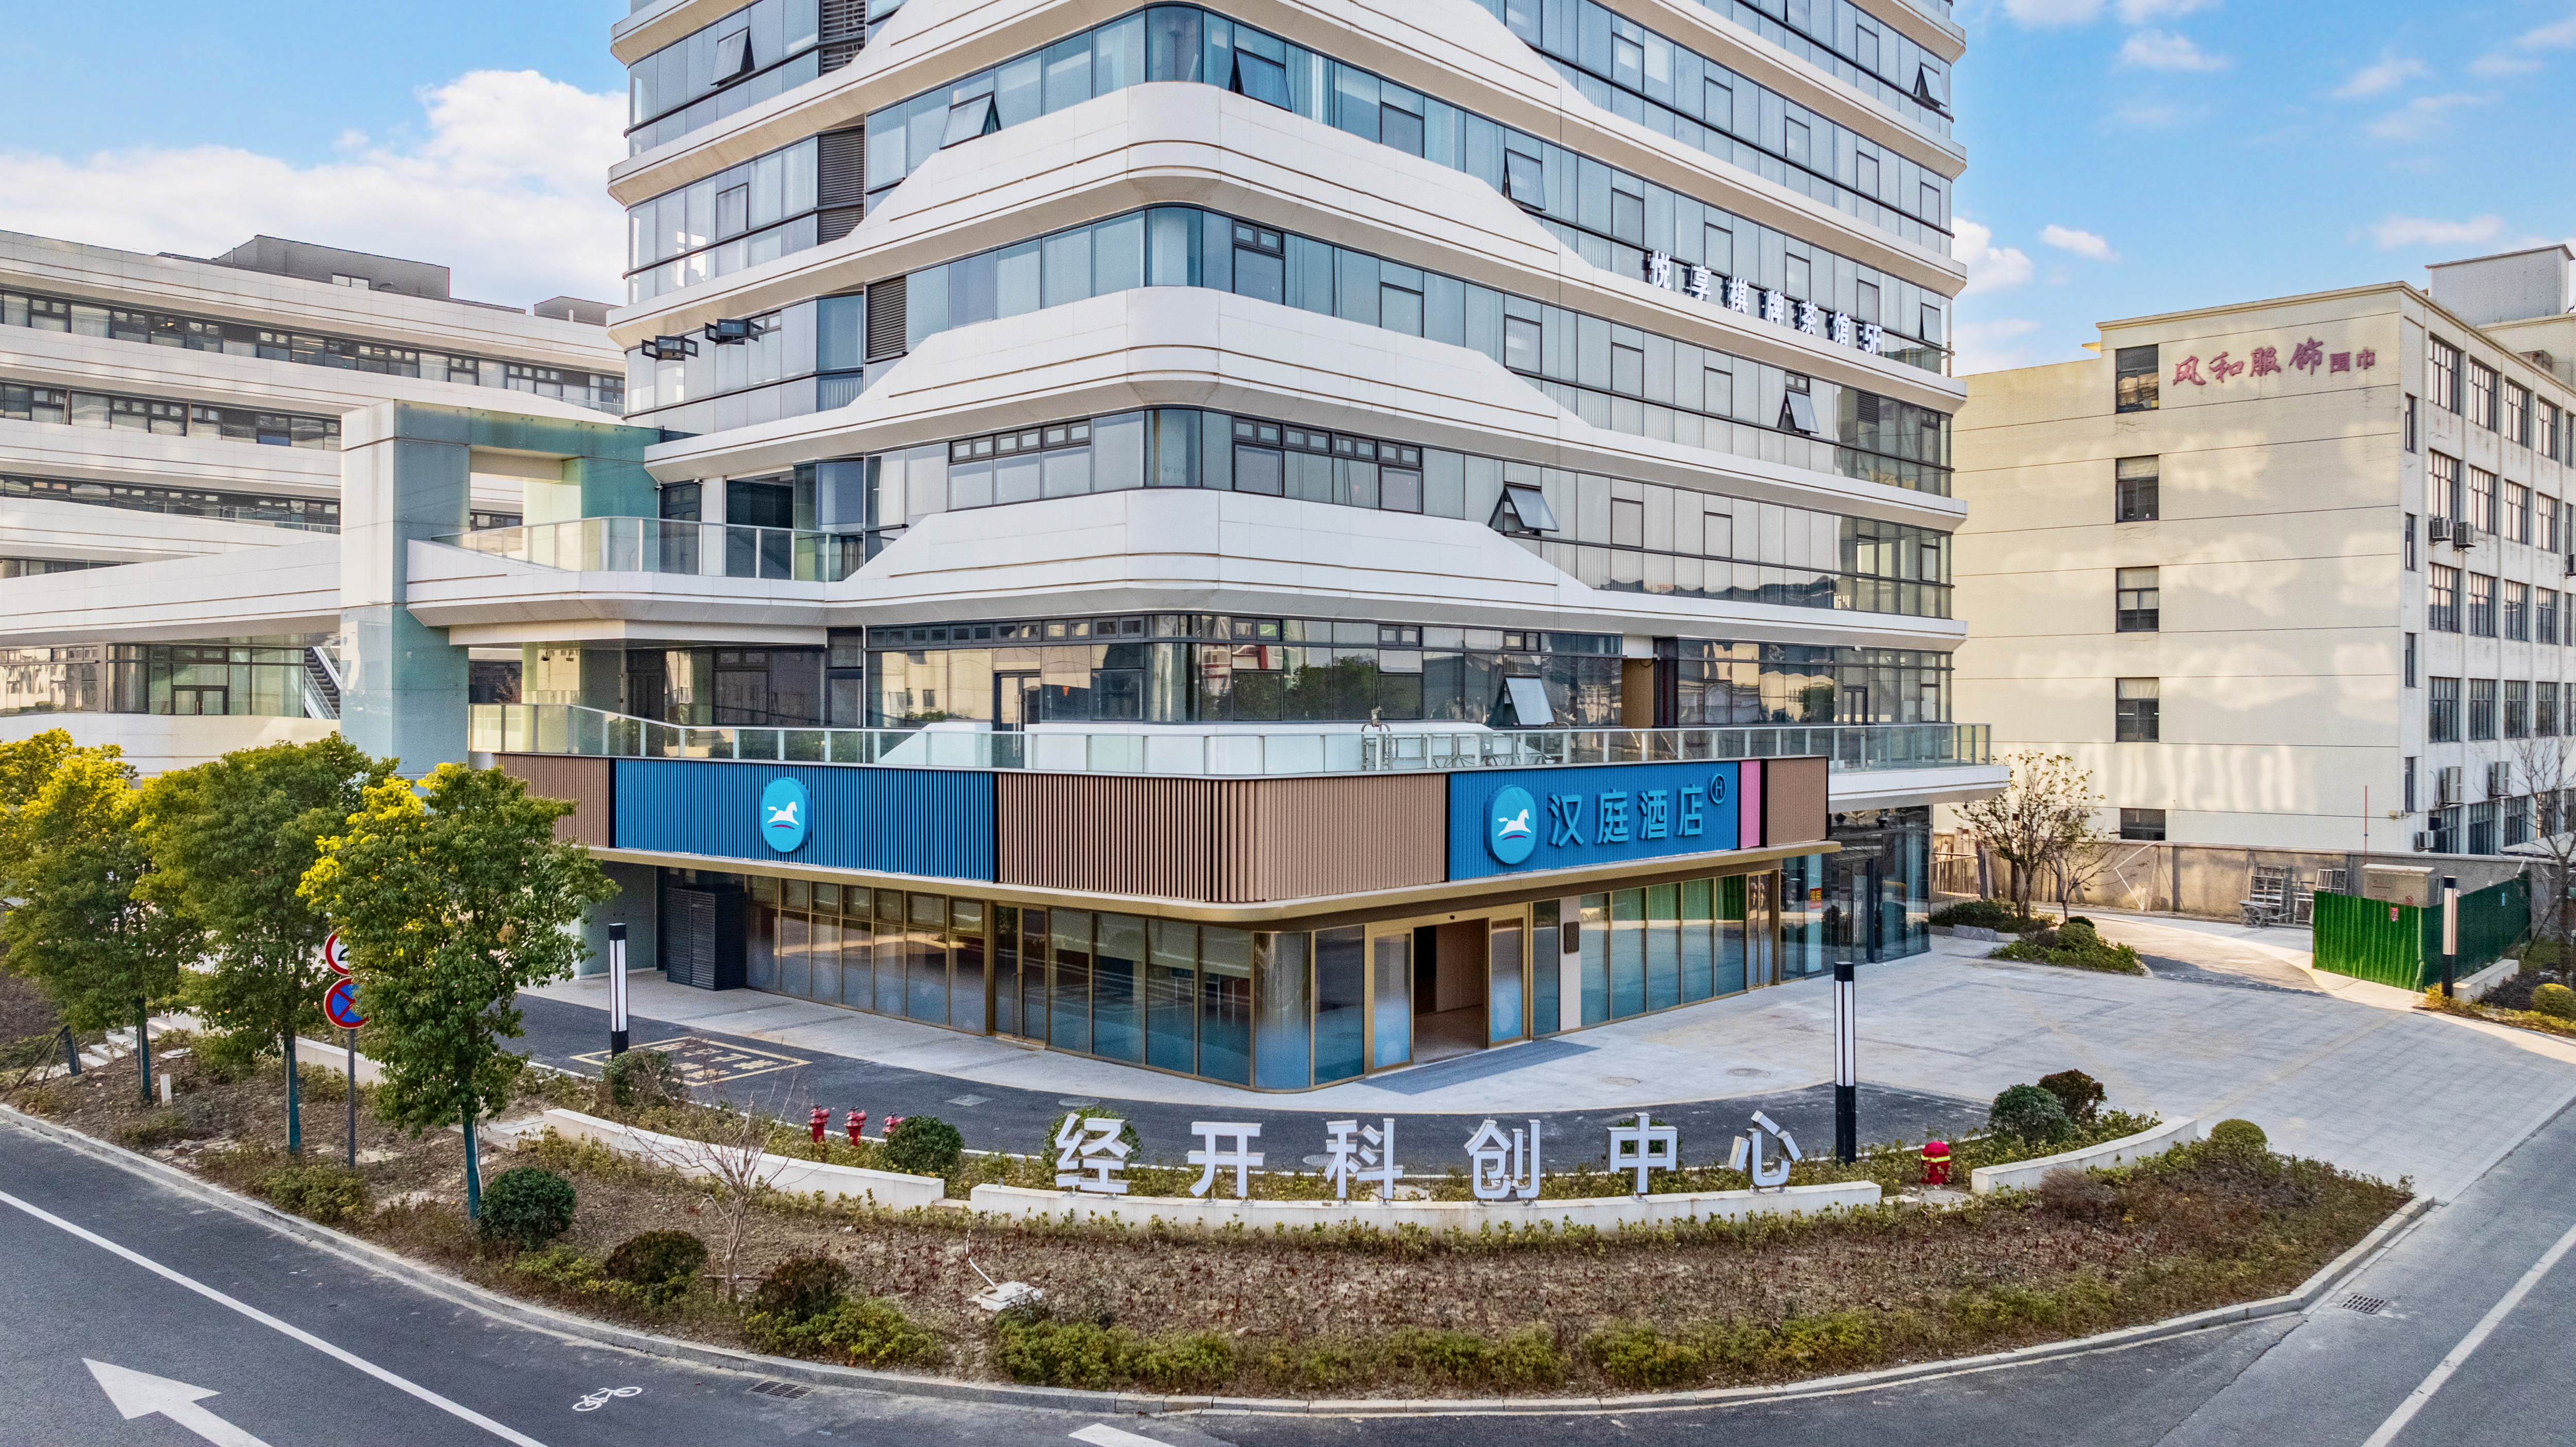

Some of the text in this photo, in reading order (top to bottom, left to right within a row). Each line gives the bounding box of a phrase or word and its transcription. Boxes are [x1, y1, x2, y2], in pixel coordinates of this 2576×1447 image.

[1549, 784, 1704, 847] 汉庭酒店
[1054, 1112, 1805, 1200] 经开科创中心
